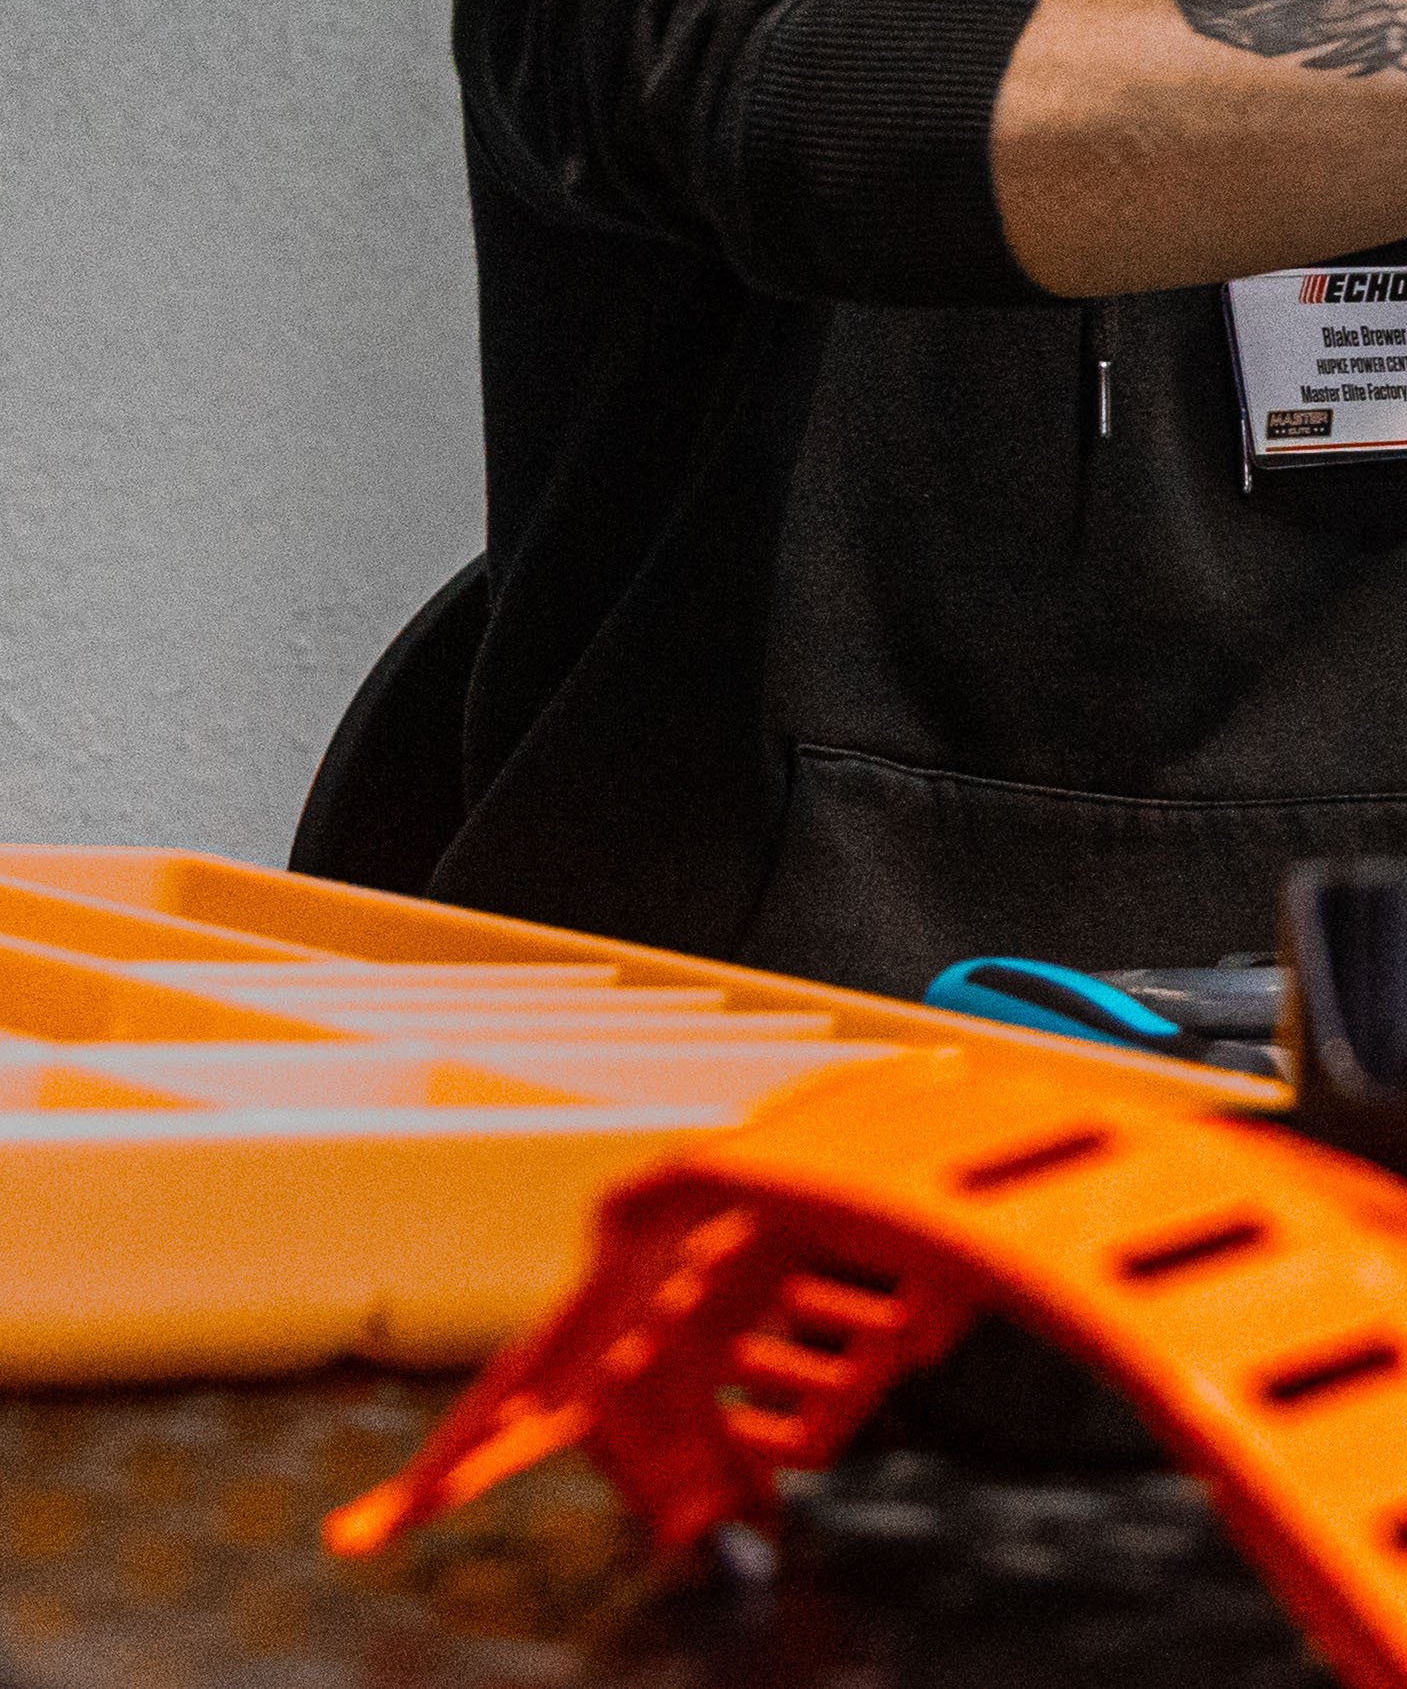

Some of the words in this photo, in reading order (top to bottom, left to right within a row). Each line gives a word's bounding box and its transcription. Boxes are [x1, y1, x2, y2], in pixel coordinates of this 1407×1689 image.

[1321, 325, 1360, 348] Blake
[1360, 325, 1407, 346] Brewer
[1349, 356, 1386, 374] POWER
[1300, 385, 1341, 403] Master
[1341, 383, 1367, 402] Elite
[1366, 382, 1407, 402] Factory
